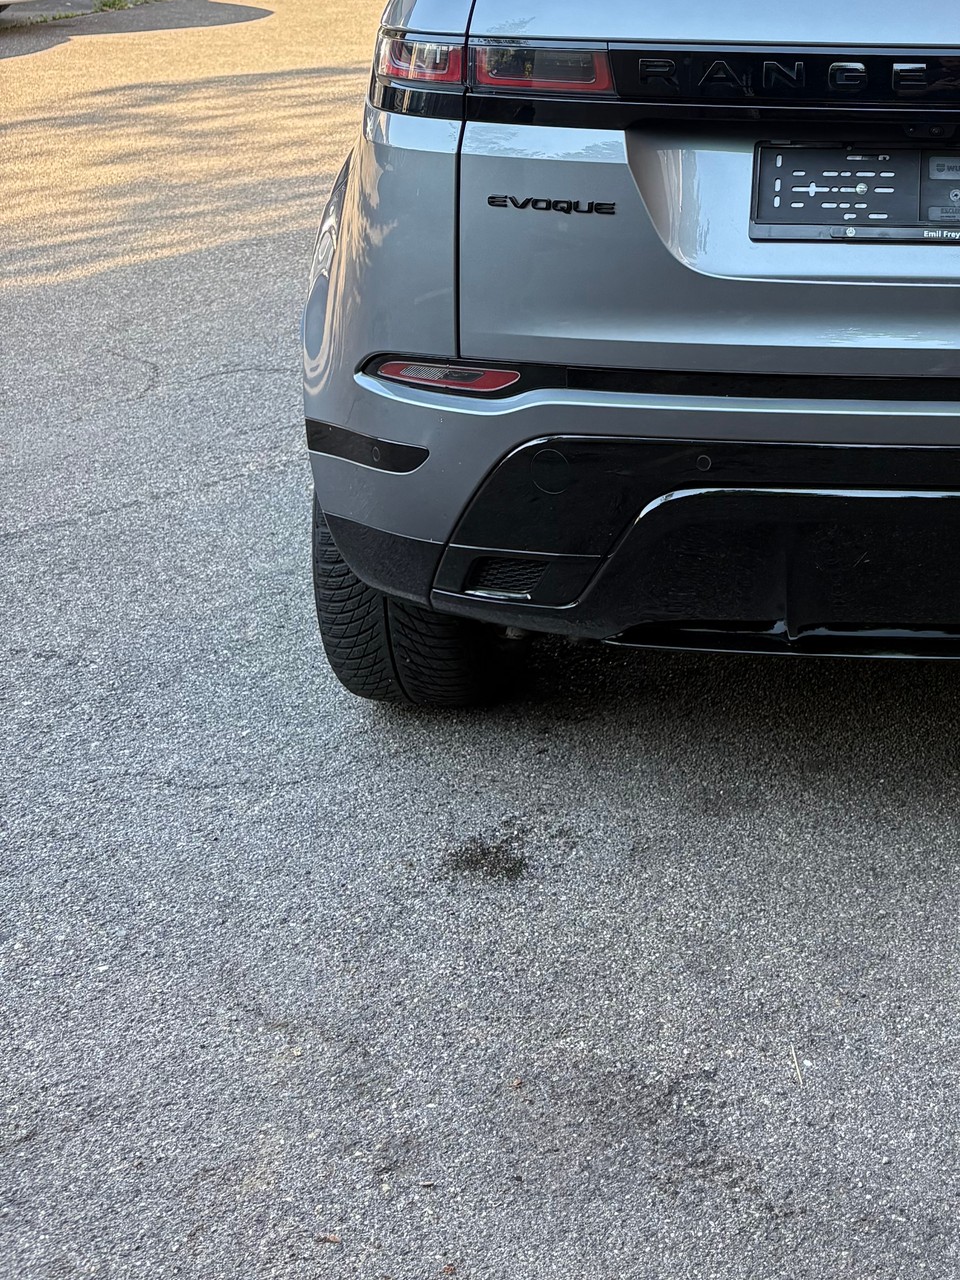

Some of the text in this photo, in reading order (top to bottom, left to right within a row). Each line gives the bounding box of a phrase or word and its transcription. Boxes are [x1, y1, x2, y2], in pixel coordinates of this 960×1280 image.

[638, 57, 927, 91] RANGE
[487, 194, 616, 215] EVOQUE
[923, 230, 960, 239] Emil Frey
